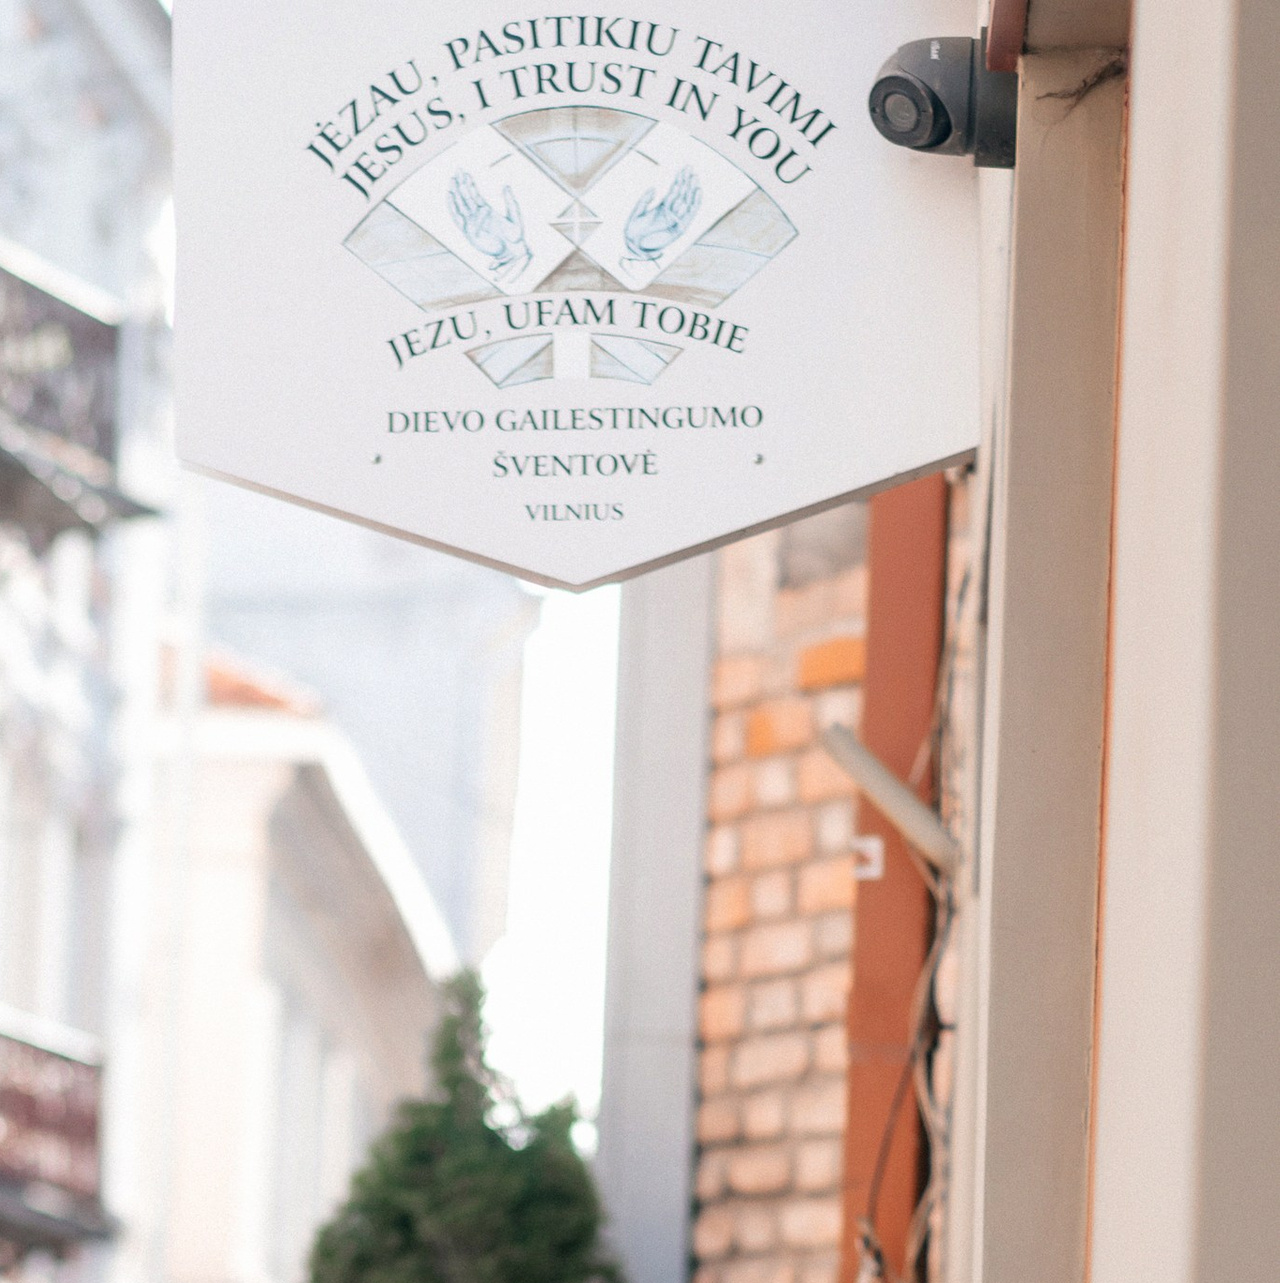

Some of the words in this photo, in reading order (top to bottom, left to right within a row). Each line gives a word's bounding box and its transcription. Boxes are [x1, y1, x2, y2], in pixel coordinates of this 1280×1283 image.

[306, 58, 439, 171] JĖZAU,
[443, 16, 680, 71] PASITIKIU
[694, 36, 838, 148] TAVIMI
[340, 98, 465, 200] JESUS,
[472, 79, 492, 110] I
[499, 61, 657, 98] TRUST
[664, 76, 720, 122] IN
[727, 106, 813, 185] YOU
[386, 311, 492, 368] JEZU,
[503, 298, 616, 331] UFAM
[632, 300, 750, 354] TOBIE
[387, 410, 485, 433] DIEVO
[495, 405, 764, 432] GAILESTINGUMO
[493, 449, 658, 477] ŠVENTOVĖ
[525, 503, 624, 522] VILNIUS
